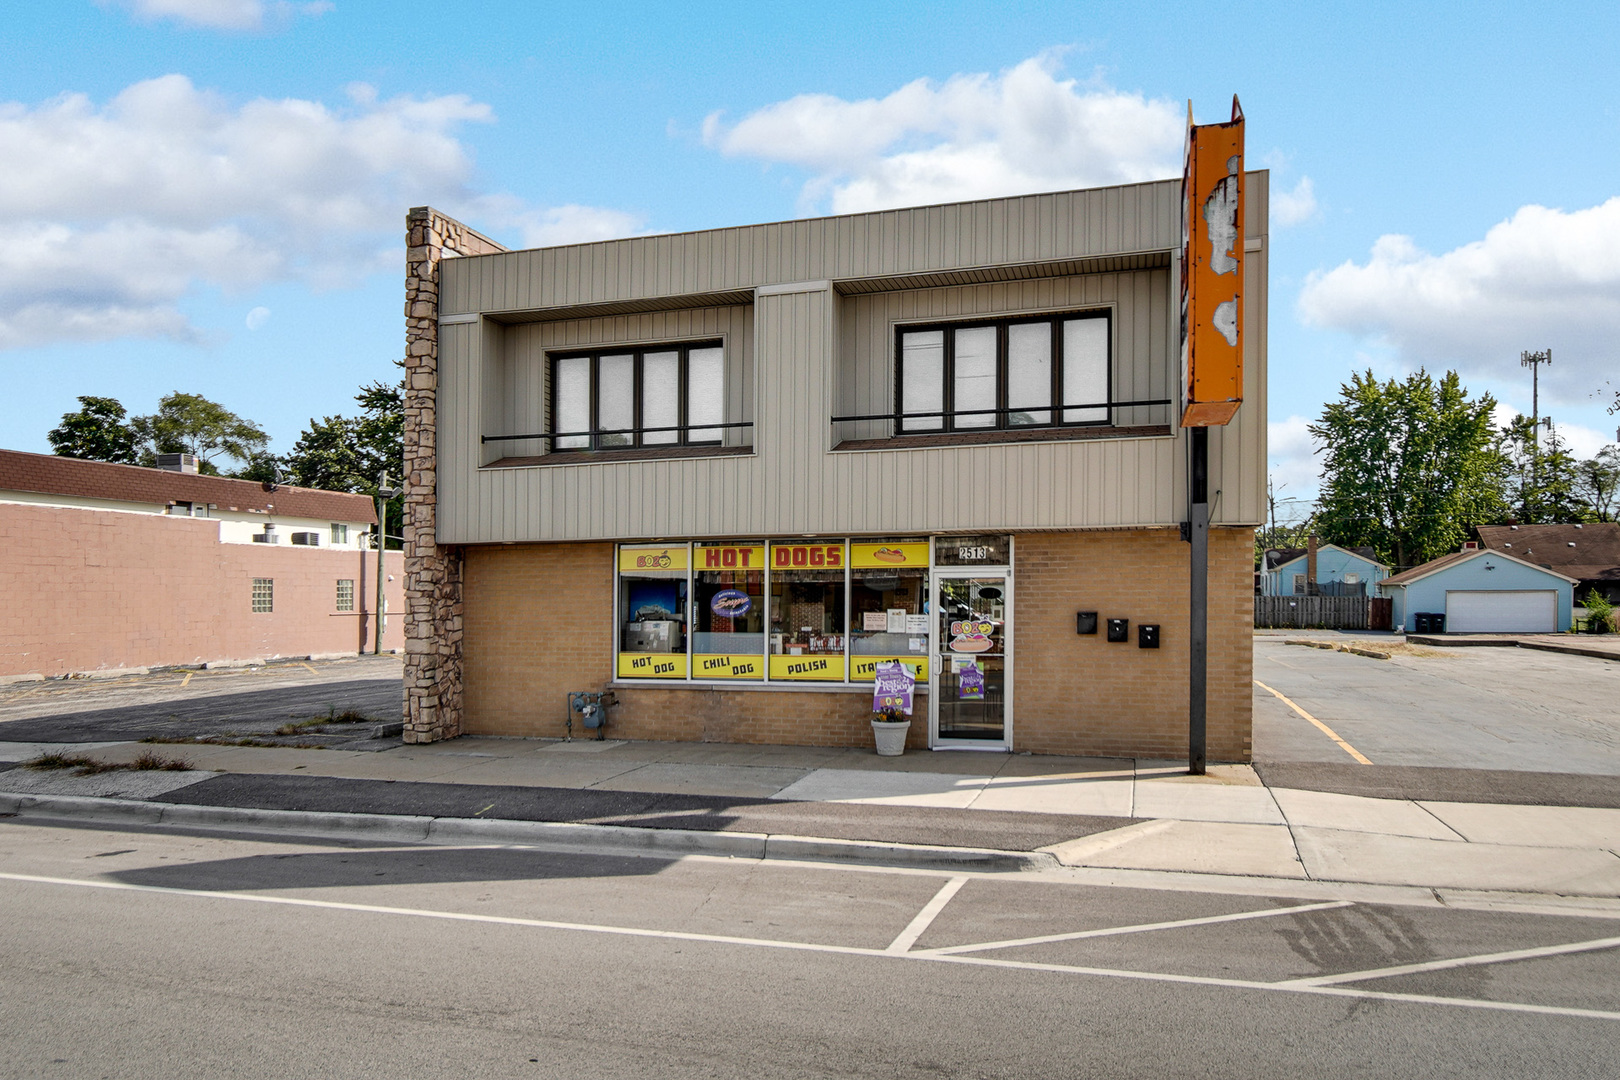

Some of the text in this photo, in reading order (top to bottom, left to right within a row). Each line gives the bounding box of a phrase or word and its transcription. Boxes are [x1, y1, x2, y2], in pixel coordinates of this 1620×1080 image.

[705, 546, 842, 567] HOT DOGS
[959, 547, 986, 559] 2513
[632, 656, 652, 669] HOT
[654, 662, 675, 674] DOG
[703, 656, 731, 670] CHILI
[732, 663, 754, 675] DOG
[787, 659, 828, 675] POLISH
